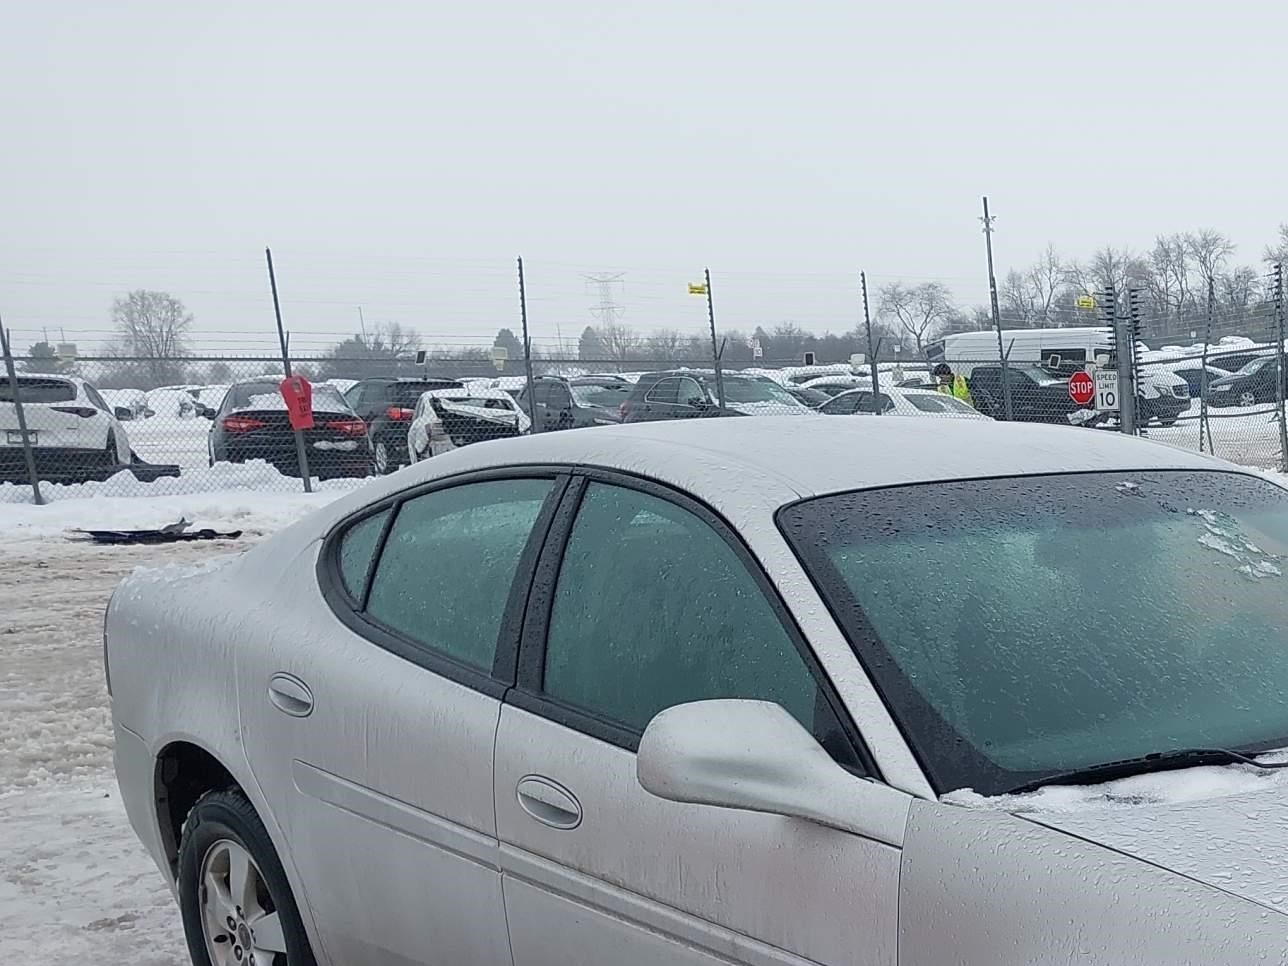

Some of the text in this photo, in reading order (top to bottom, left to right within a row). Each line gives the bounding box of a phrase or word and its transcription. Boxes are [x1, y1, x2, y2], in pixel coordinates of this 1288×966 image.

[1070, 381, 1093, 394] STOP
[1098, 382, 1115, 390] LIMIT
[1100, 391, 1116, 407] 10
